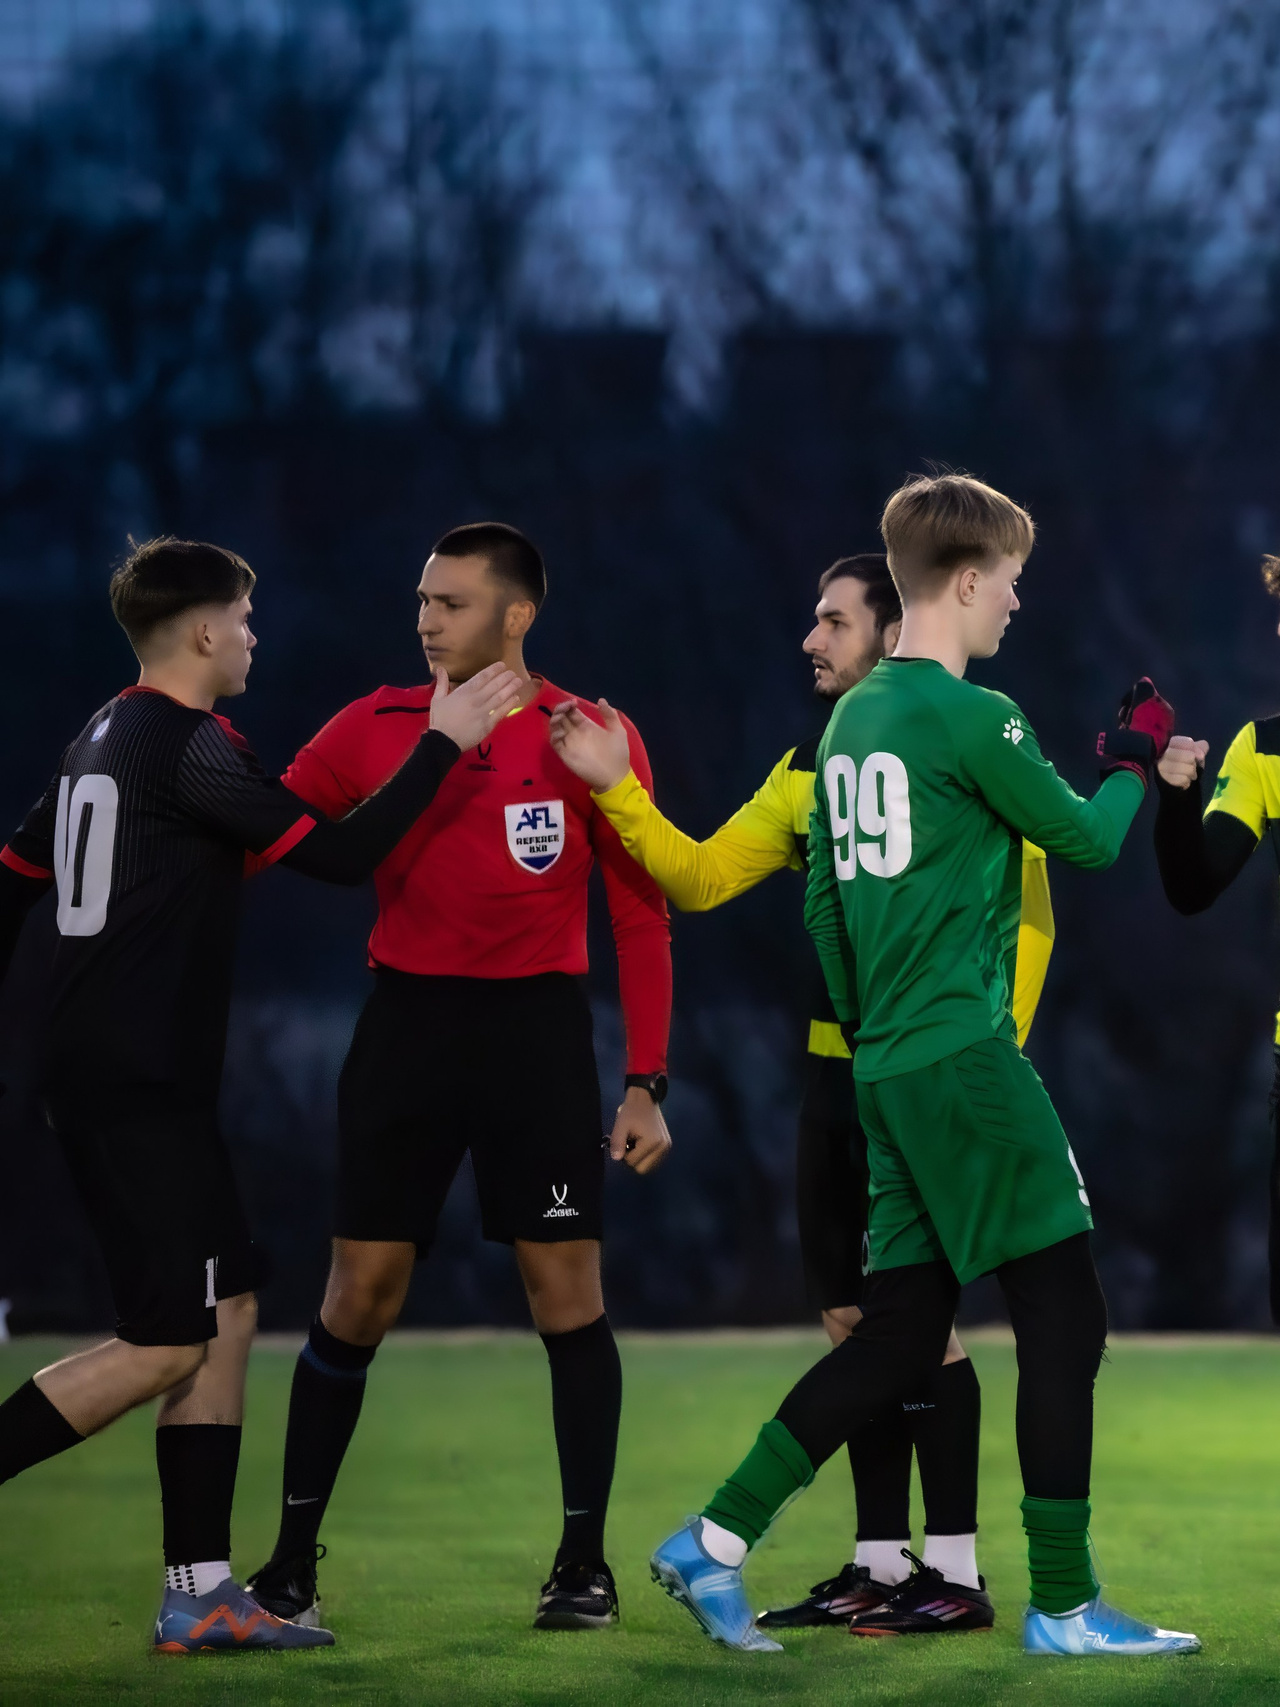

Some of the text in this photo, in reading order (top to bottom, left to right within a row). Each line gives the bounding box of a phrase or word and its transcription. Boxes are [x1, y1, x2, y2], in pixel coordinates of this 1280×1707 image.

[54, 774, 119, 937] 10
[515, 807, 558, 832] AFL
[824, 751, 912, 880] 99
[205, 1255, 219, 1308] 1
